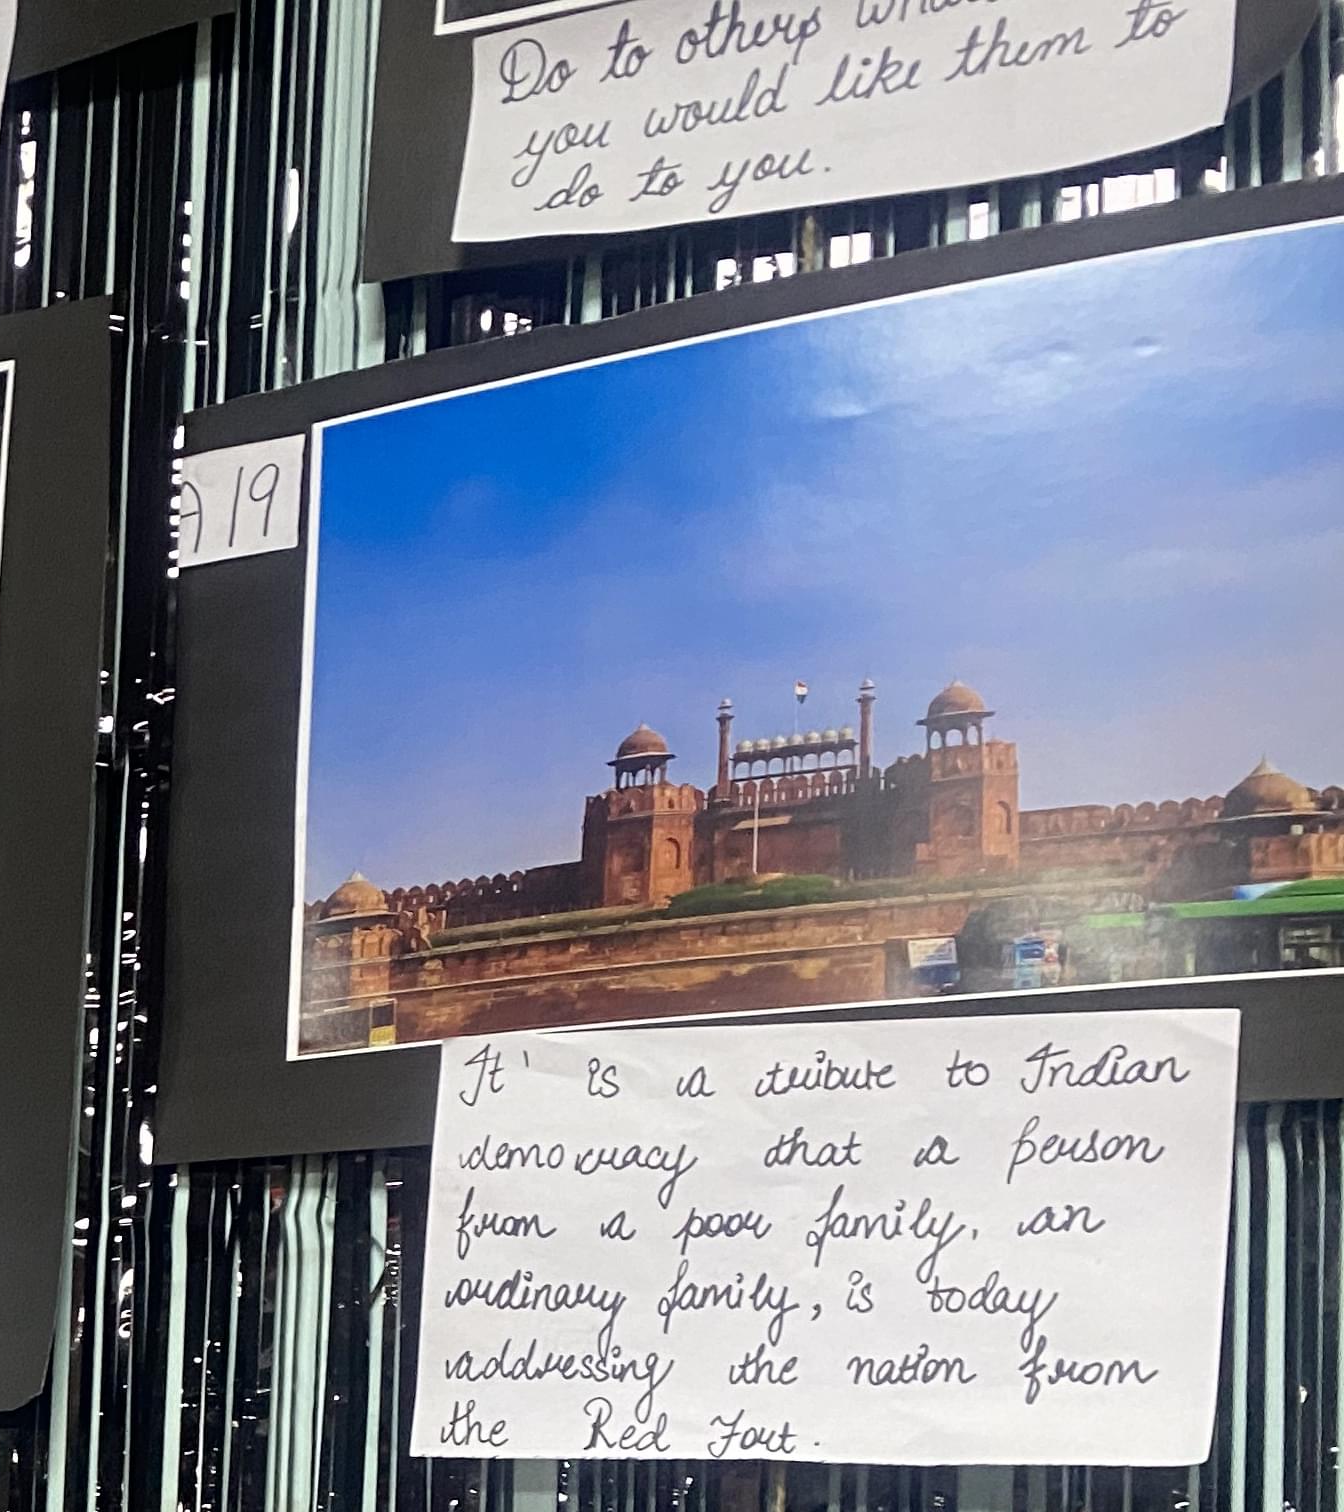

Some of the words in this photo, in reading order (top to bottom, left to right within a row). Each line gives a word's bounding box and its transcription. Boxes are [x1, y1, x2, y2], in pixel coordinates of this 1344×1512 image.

[500, 38, 576, 104] Do
[599, 18, 652, 83] to
[676, 0, 822, 66] others
[512, 118, 610, 188] you
[644, 62, 787, 138] would
[815, 46, 922, 105] like
[945, 16, 1092, 82] them
[1114, 0, 1188, 48] to
[534, 163, 604, 212] do
[629, 156, 685, 203] to
[707, 147, 831, 214] you.
[587, 1057, 621, 1098] is
[676, 1065, 715, 1097] a
[755, 1050, 896, 1098] tribute
[946, 1049, 990, 1088] to
[1020, 1042, 1191, 1094] Indian
[764, 1126, 862, 1169] that
[914, 1135, 960, 1168] a
[1005, 1115, 1165, 1185] person
[457, 1186, 558, 1260] from
[600, 1211, 637, 1241] a
[672, 1206, 773, 1256] poor
[1017, 1204, 1106, 1238] an
[445, 1270, 627, 1356] ordinary
[847, 1270, 874, 1313] is
[926, 1270, 1059, 1353] today
[445, 1339, 675, 1424] addressing
[729, 1344, 798, 1385] the
[847, 1344, 977, 1386] nation
[1019, 1335, 1159, 1405] from
[440, 1399, 510, 1447] the
[584, 1396, 671, 1451] Red
